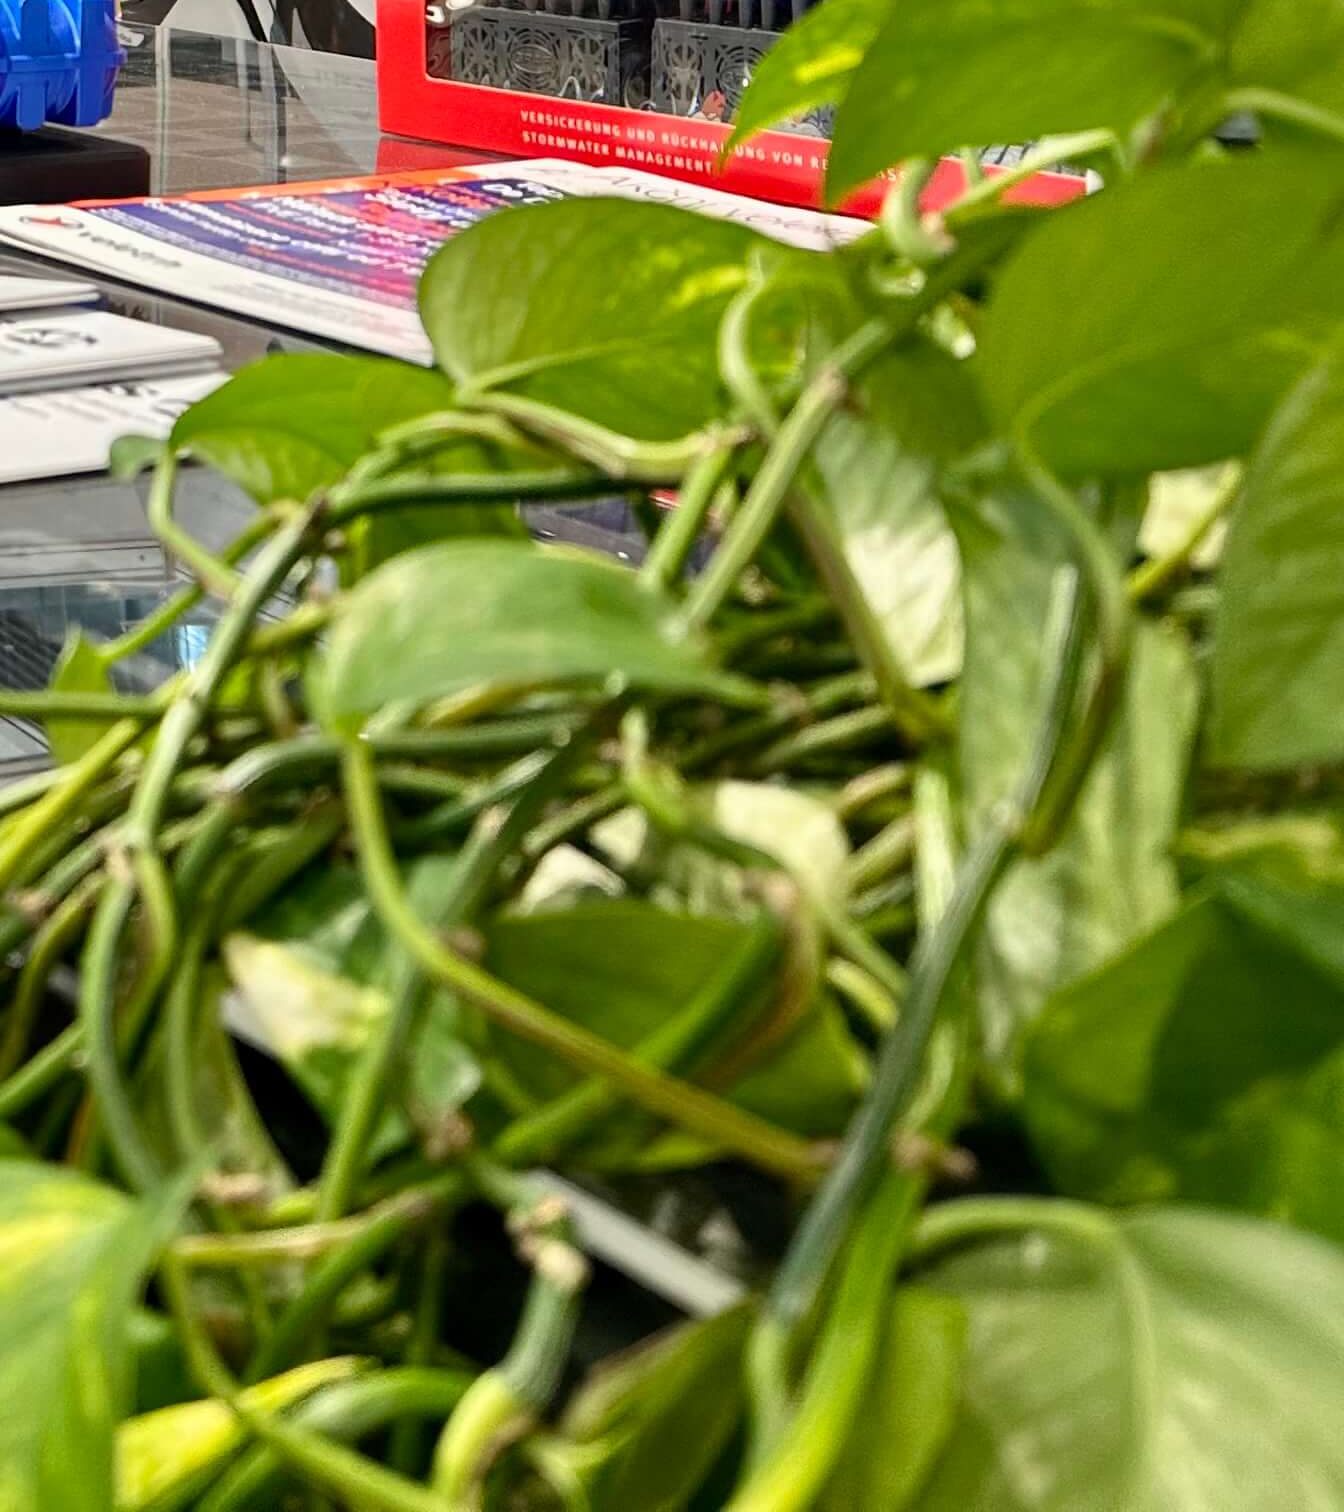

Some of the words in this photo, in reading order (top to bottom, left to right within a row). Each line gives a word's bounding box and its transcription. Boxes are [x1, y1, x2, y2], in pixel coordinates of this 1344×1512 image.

[520, 110, 622, 138] VERSICKERUNG
[626, 128, 656, 143] UND
[662, 131, 767, 162] RÜCKHAUNG
[771, 152, 805, 167] VON
[522, 130, 612, 156] STORMWATER
[615, 144, 713, 175] MANAGEMENT
